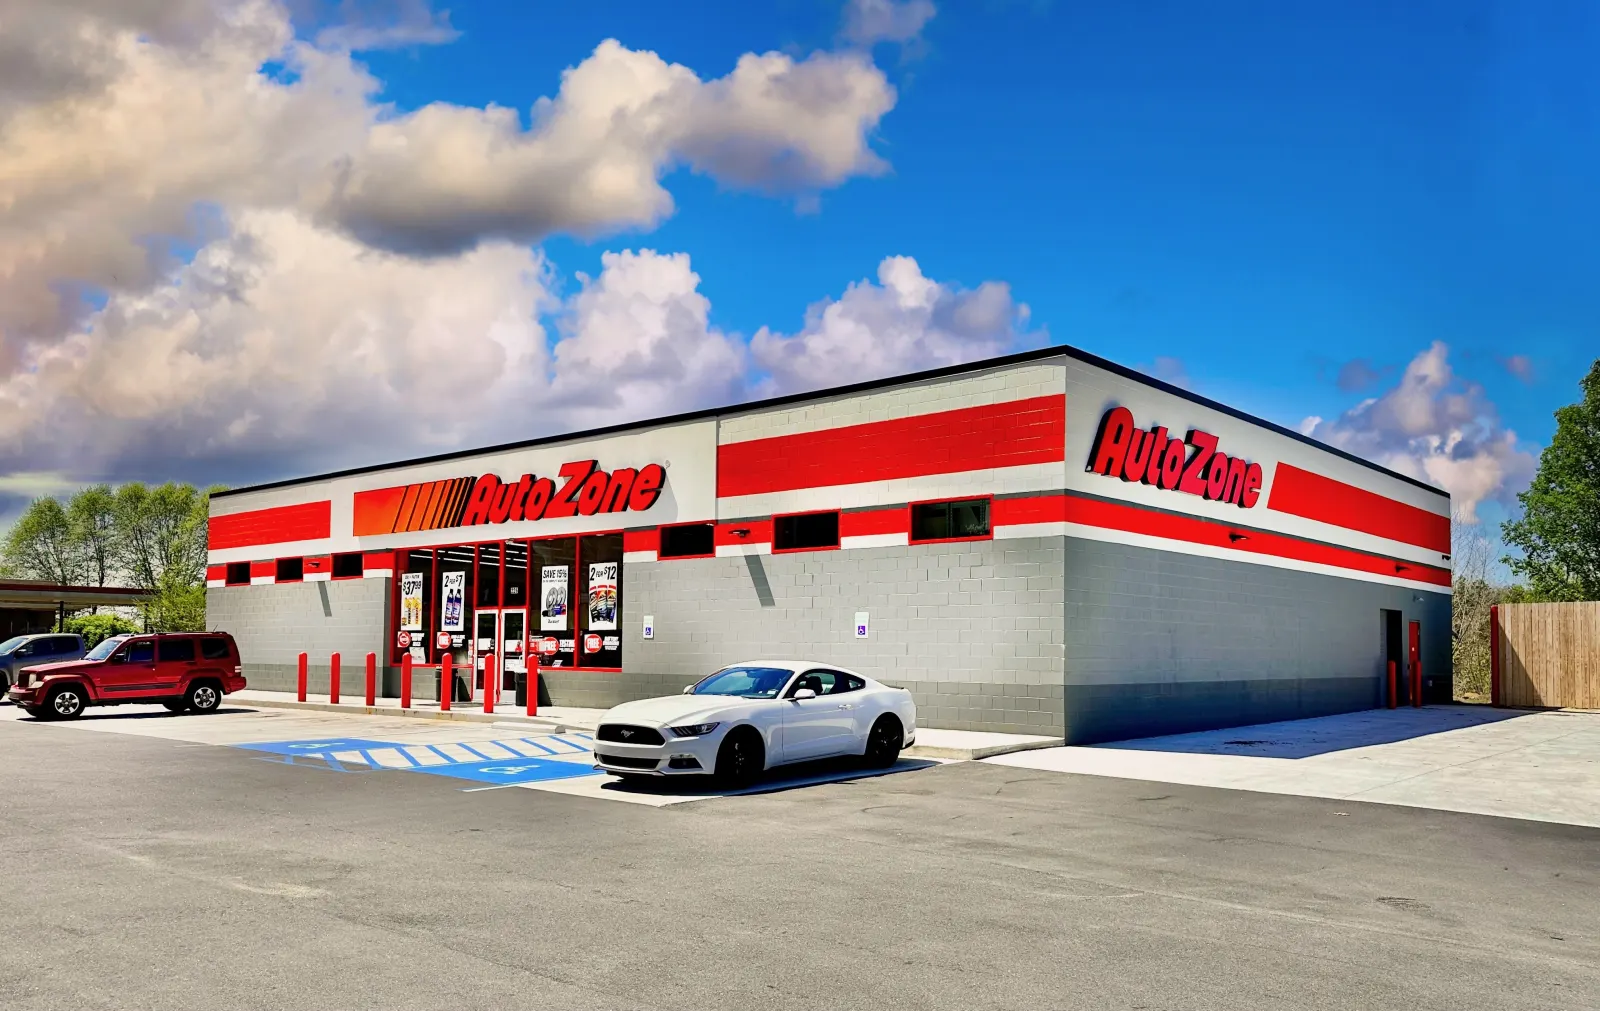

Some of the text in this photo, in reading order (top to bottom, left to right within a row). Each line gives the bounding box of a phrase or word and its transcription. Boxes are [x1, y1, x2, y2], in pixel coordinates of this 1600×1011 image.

[1088, 406, 1262, 508] AutoZone
[462, 459, 665, 526] AutoZone
[444, 575, 450, 587] 2
[456, 574, 463, 587] $7
[543, 569, 556, 578] SAVE
[590, 567, 596, 581] 2
[604, 566, 617, 580] $12
